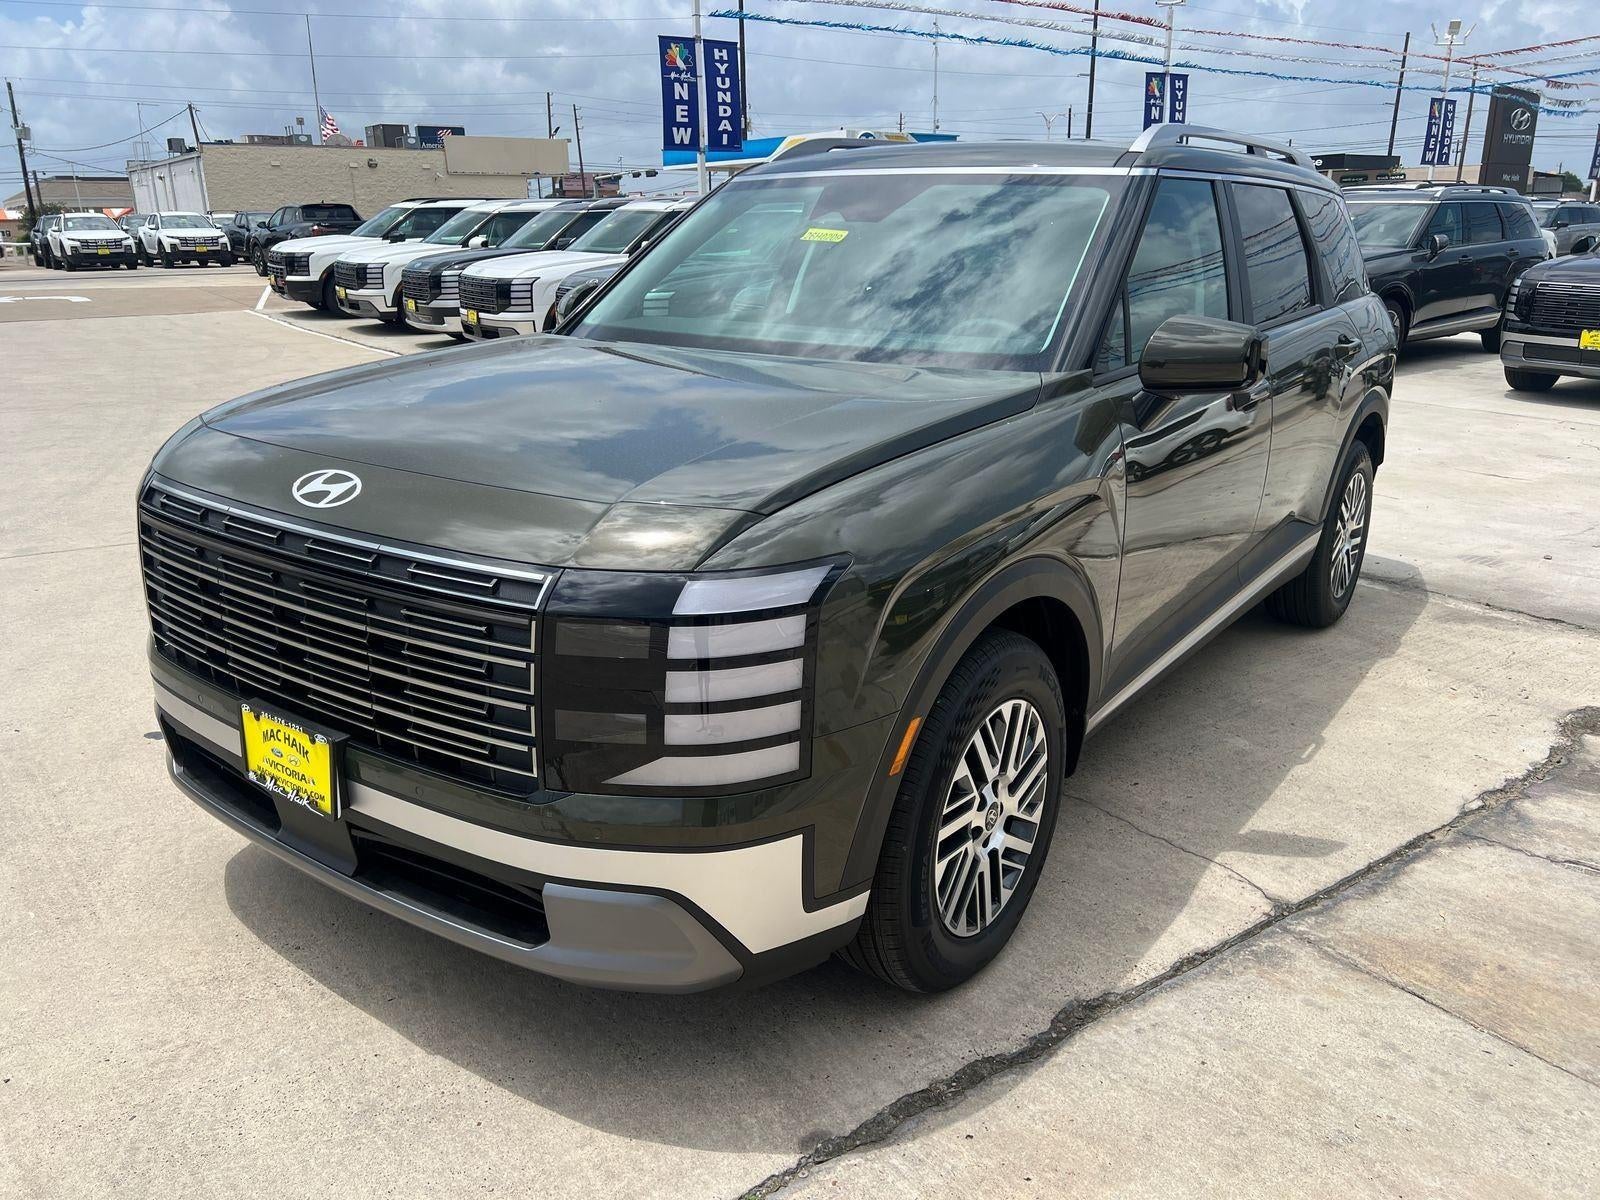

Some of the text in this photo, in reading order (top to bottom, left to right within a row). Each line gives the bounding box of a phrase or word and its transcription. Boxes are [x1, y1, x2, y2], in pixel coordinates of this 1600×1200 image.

[672, 82, 692, 144] NEW
[713, 48, 732, 144] HYUNDAI
[1425, 125, 1438, 162] NEW
[1442, 104, 1453, 162] HYUNDAI
[1502, 133, 1532, 145] HYUNDAI
[262, 729, 282, 744] MAC
[283, 732, 310, 764] HAIK
[268, 757, 308, 784] VICTORIA
